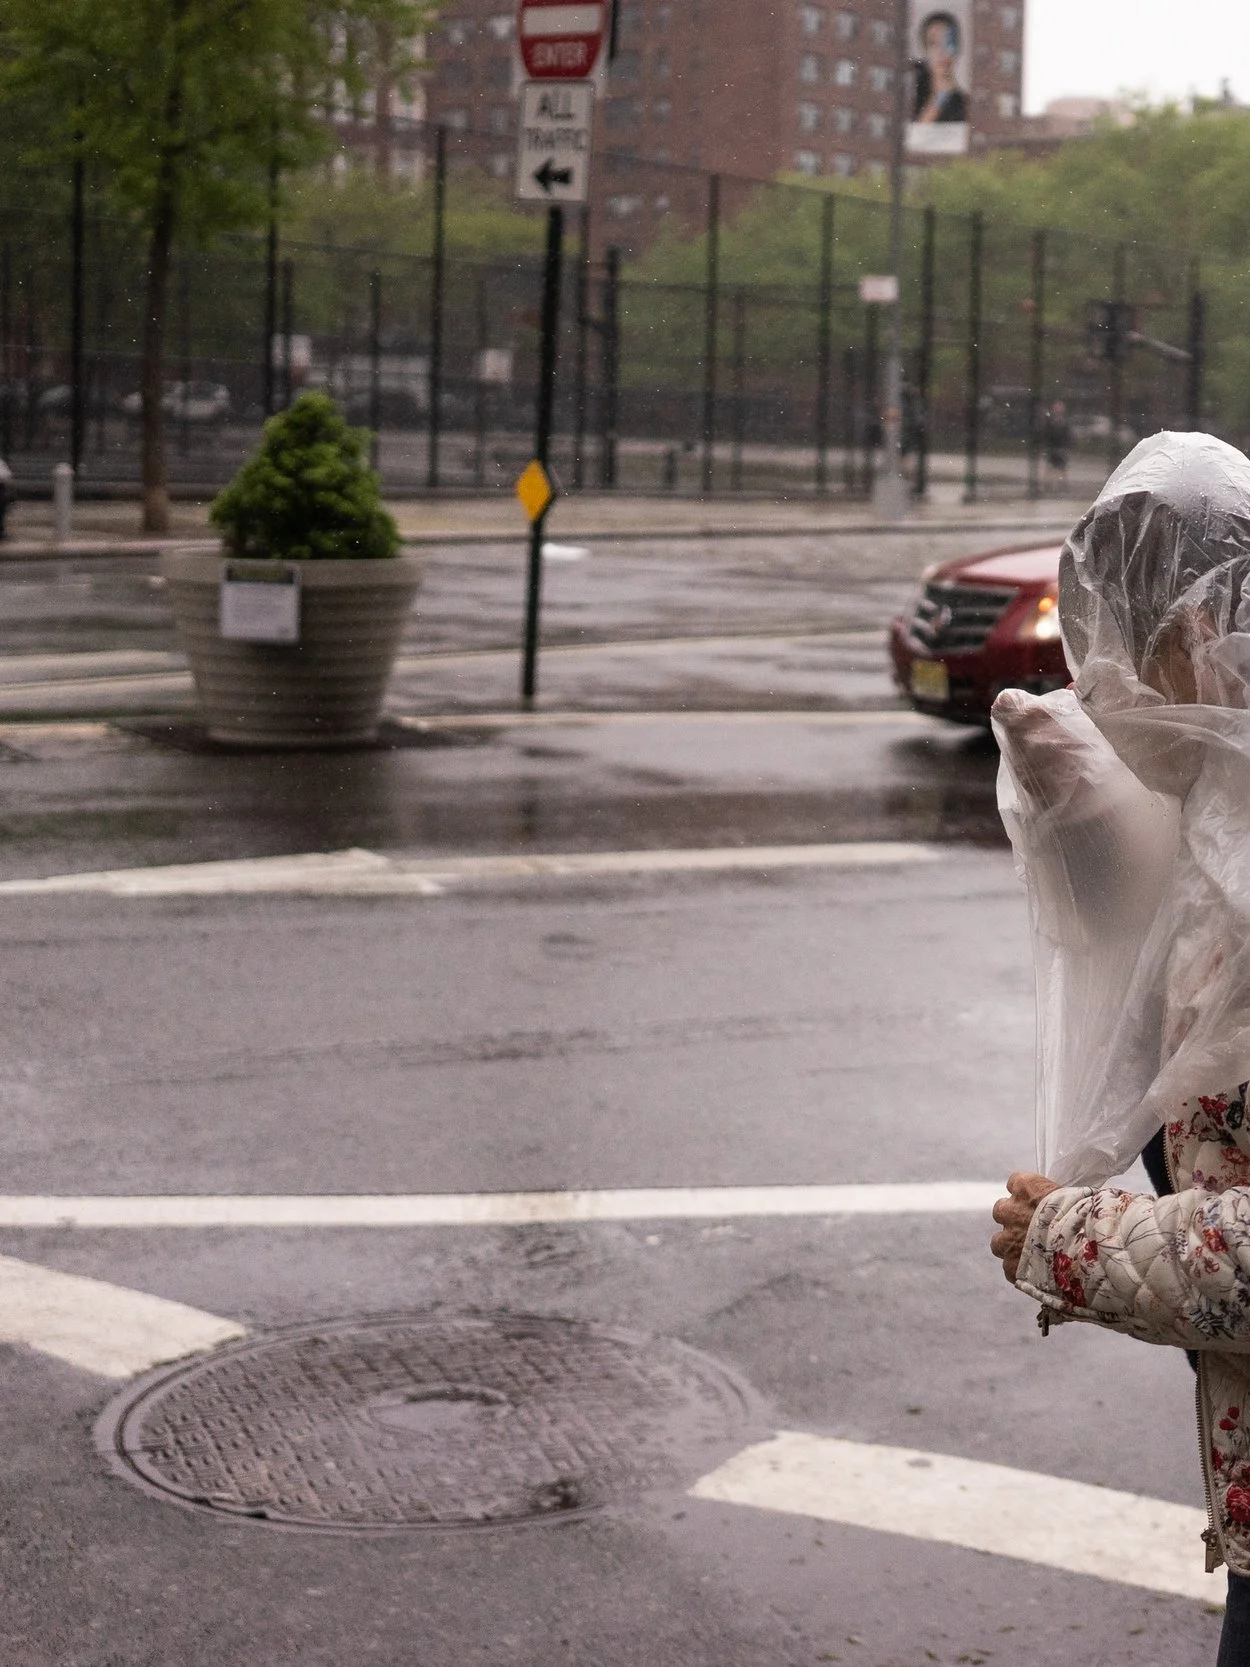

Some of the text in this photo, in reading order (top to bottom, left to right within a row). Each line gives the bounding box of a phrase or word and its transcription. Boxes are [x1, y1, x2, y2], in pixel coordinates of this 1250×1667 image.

[531, 41, 588, 67] ENTER
[537, 90, 574, 119] ALL
[525, 127, 588, 149] TRAFFIC
